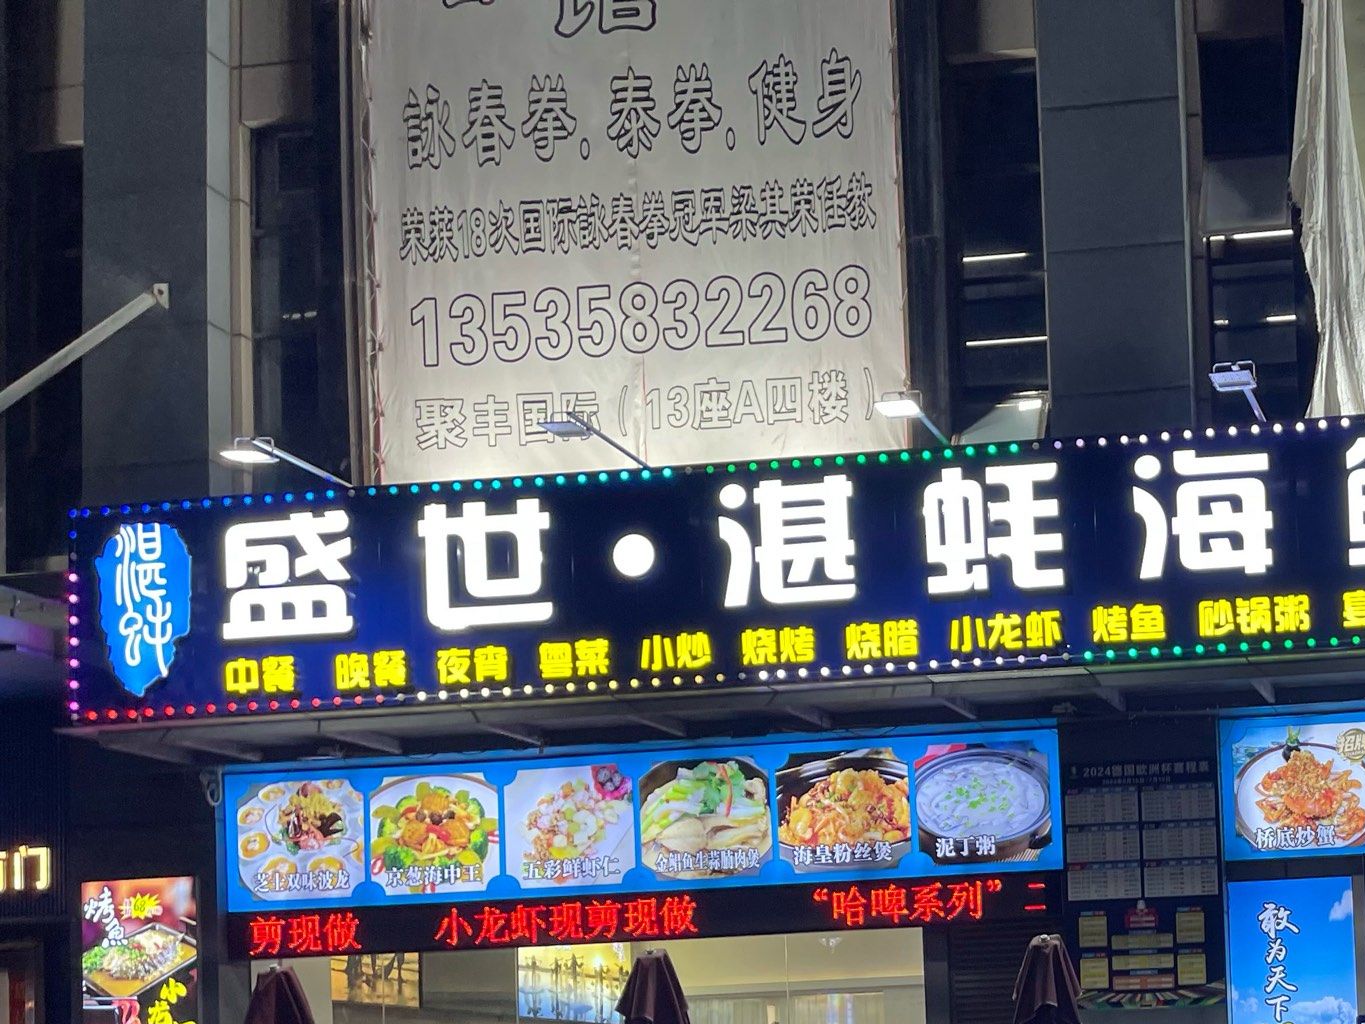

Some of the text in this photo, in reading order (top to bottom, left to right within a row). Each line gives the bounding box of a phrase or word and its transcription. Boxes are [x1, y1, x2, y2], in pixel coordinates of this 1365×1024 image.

[410, 264, 872, 367] 13535832268
[224, 655, 295, 694] 中餐
[334, 649, 407, 691] 晚餐
[436, 646, 509, 685] 夜宵
[538, 638, 610, 679] 粤菜
[640, 631, 712, 671] 小炒
[740, 625, 816, 666] 烧烤
[844, 619, 919, 661] 烧腊
[948, 609, 1062, 654] 小龙虾
[1091, 602, 1167, 643] 烤鱼
[1197, 593, 1311, 636] 砂锅粥
[935, 835, 997, 858] 泥丁粥
[1255, 824, 1336, 849] 桥底炒蟹
[793, 841, 893, 866] 海皇粉丝煲
[385, 863, 482, 888] 京葱海中王
[522, 856, 621, 882] 五彩鲜虾仁
[248, 912, 362, 956] 剪现做
[434, 893, 699, 947] 小龙虾现剪现做
